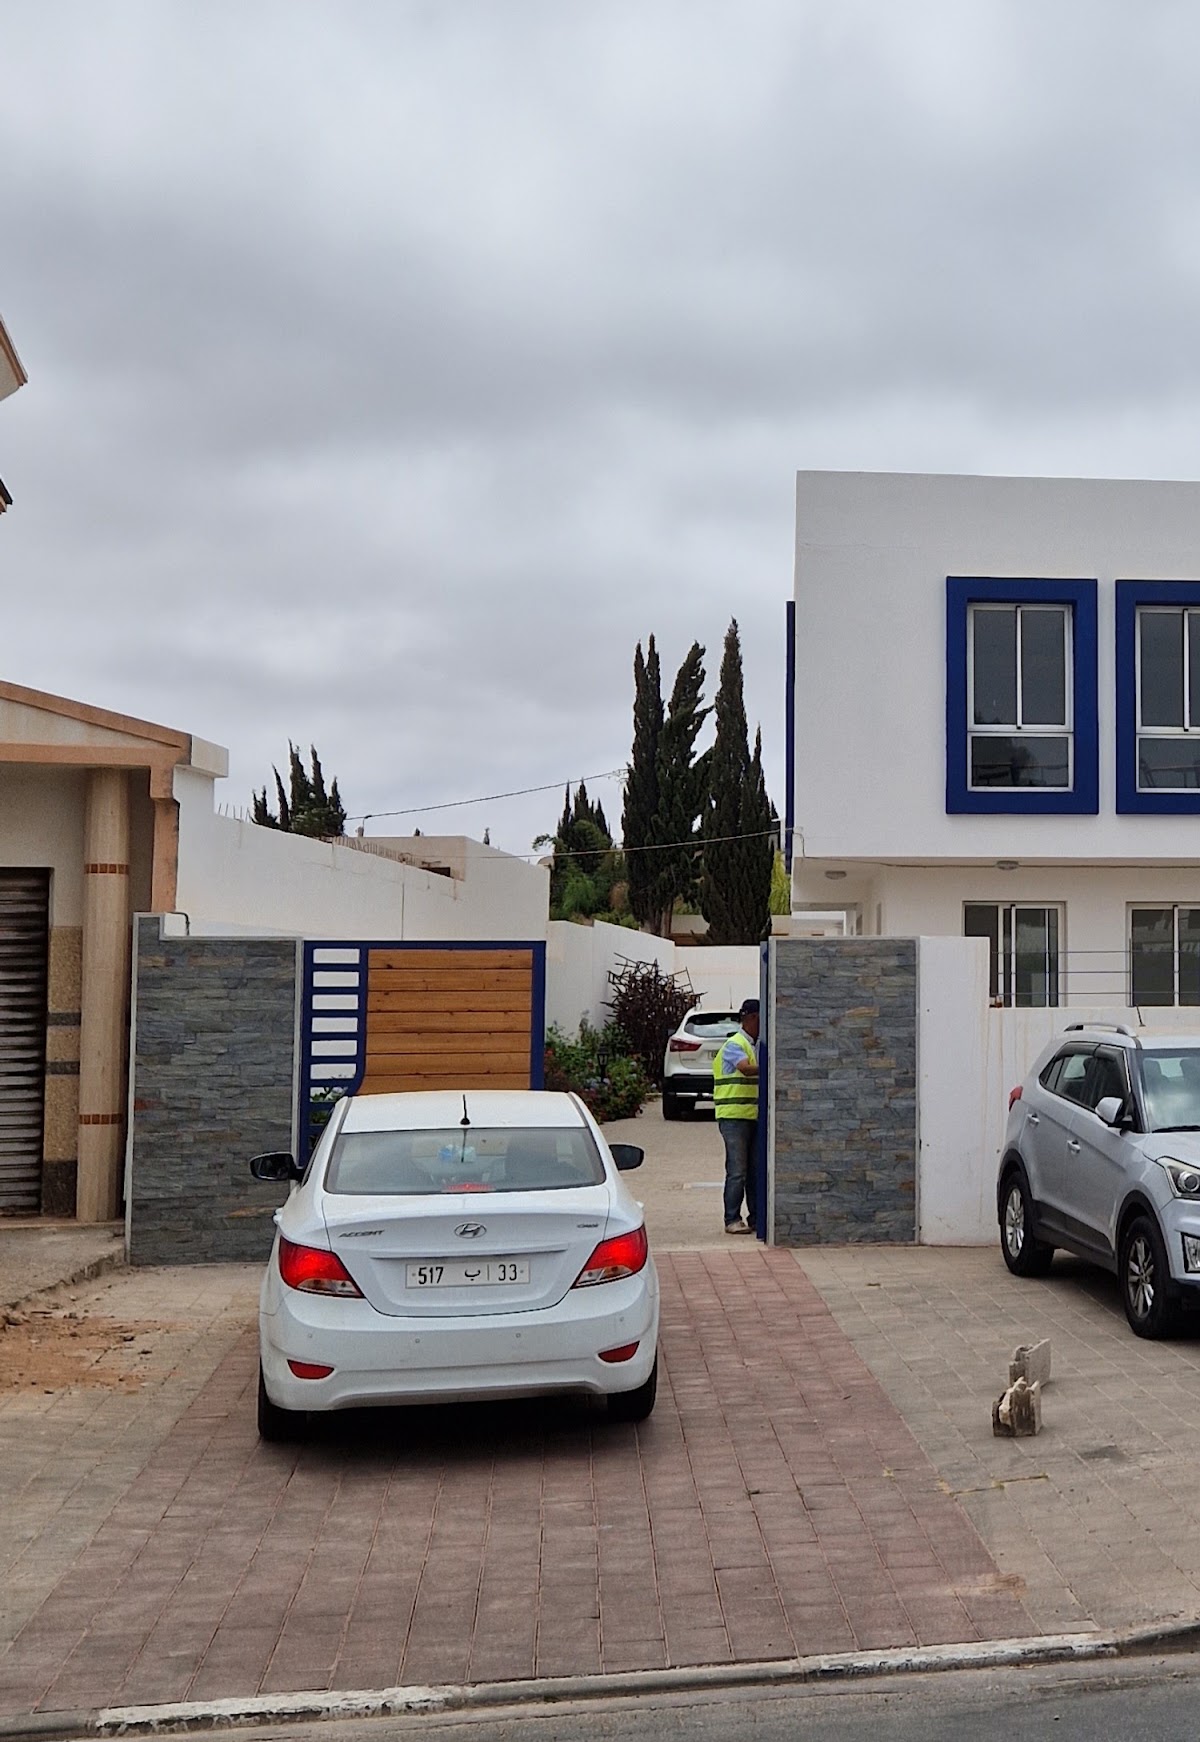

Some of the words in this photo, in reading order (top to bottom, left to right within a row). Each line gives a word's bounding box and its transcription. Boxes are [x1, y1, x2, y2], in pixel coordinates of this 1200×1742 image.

[418, 1266, 444, 1285] 517
[465, 1269, 481, 1281] ب
[498, 1264, 517, 1281] 33
